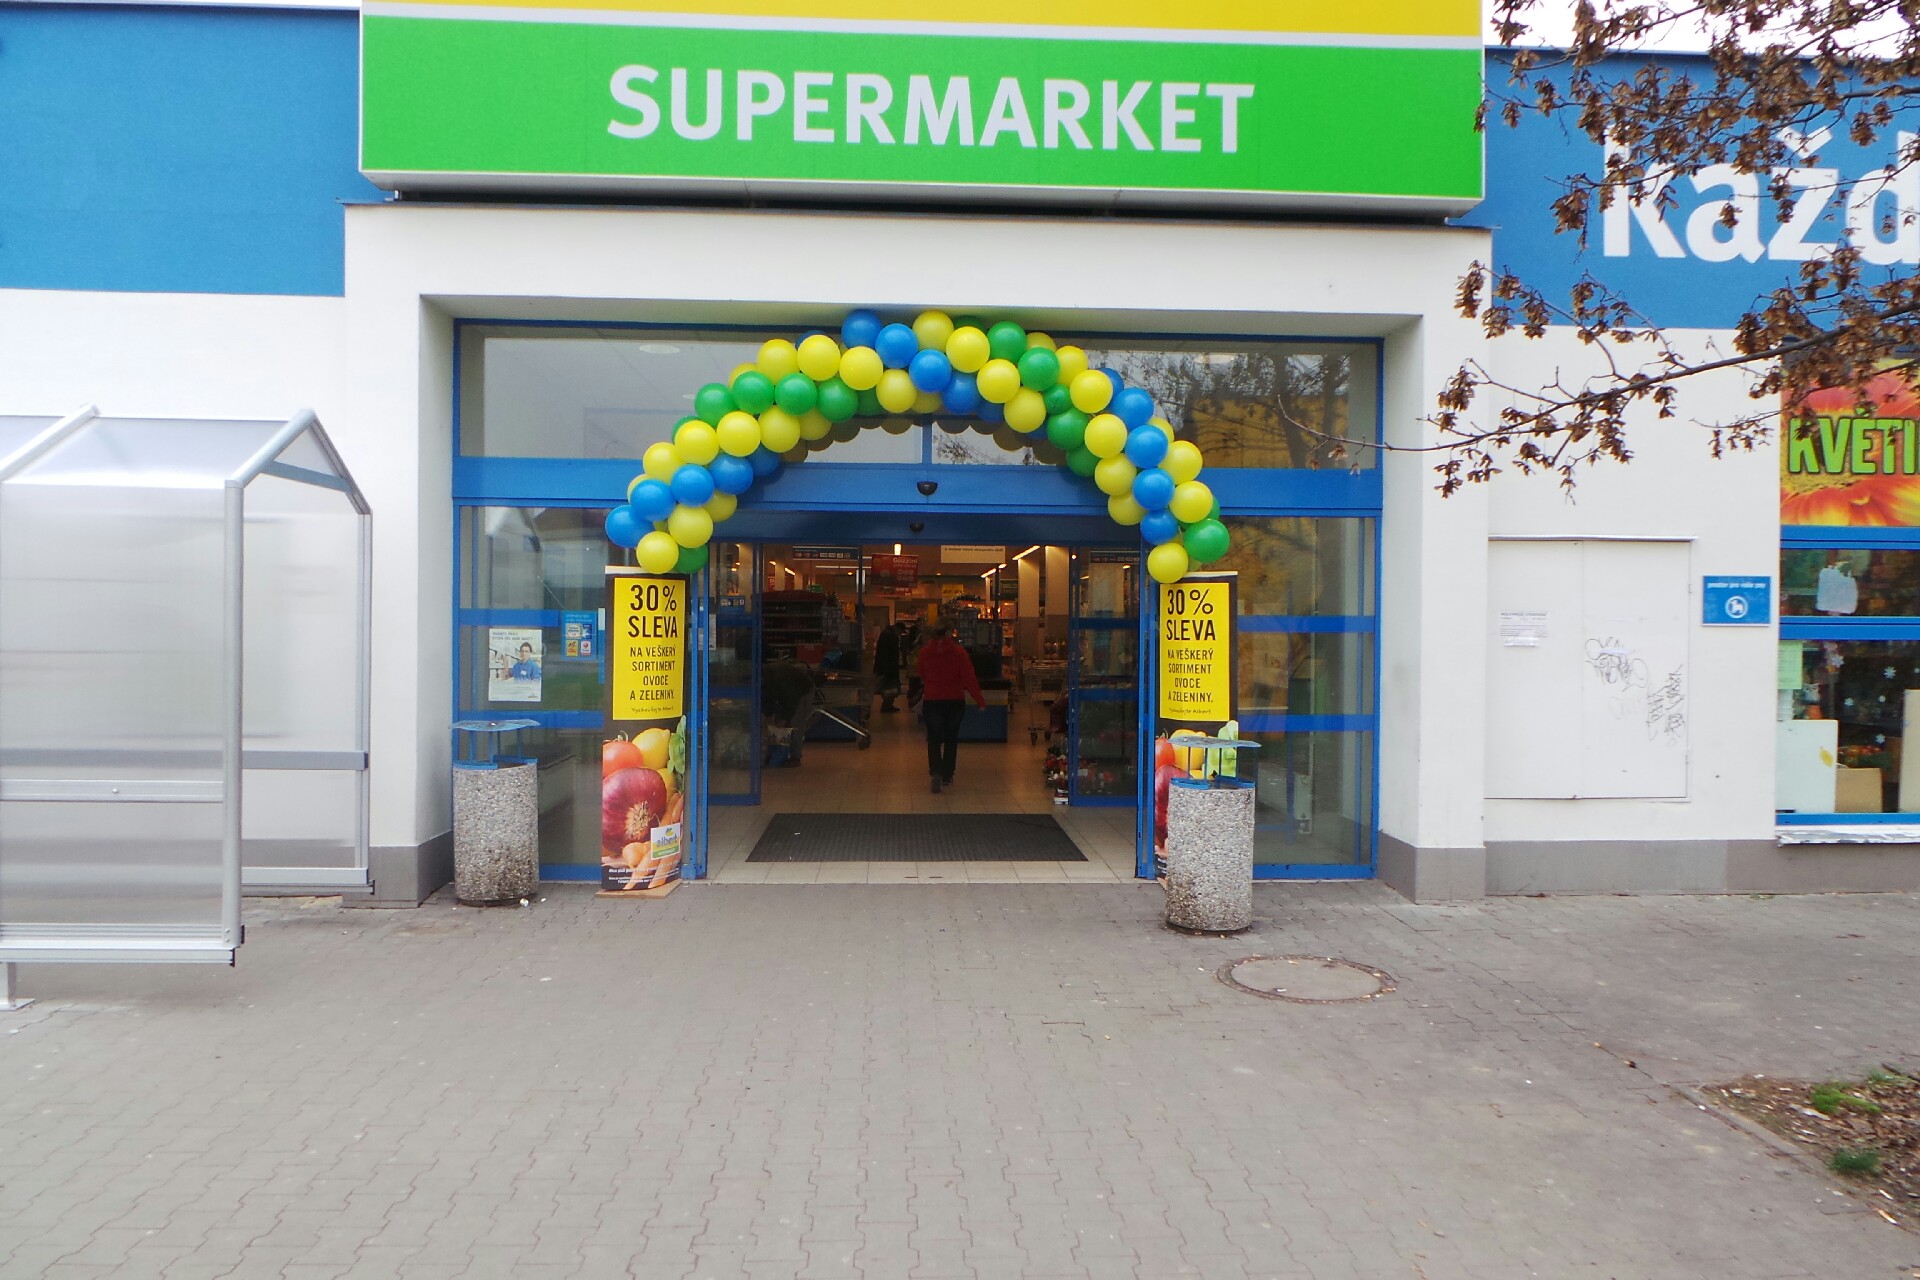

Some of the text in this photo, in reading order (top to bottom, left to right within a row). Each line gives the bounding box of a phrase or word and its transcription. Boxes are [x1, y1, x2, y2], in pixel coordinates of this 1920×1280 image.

[606, 64, 1255, 153] SUPERMARKET
[630, 584, 677, 612] 30%
[628, 615, 678, 638] SLEVA
[1166, 619, 1216, 641] SLEVA
[630, 645, 677, 657] NA VEŠKERÝ
[1167, 648, 1214, 660] NA VEŠKERÝ
[632, 660, 675, 671] SORTIMENT
[1168, 663, 1212, 674] SORTIMENT
[643, 675, 669, 686] OVOCE
[1174, 677, 1201, 688] OVOCE
[630, 690, 636, 700] A
[1168, 691, 1214, 703] A ZELENINY.
